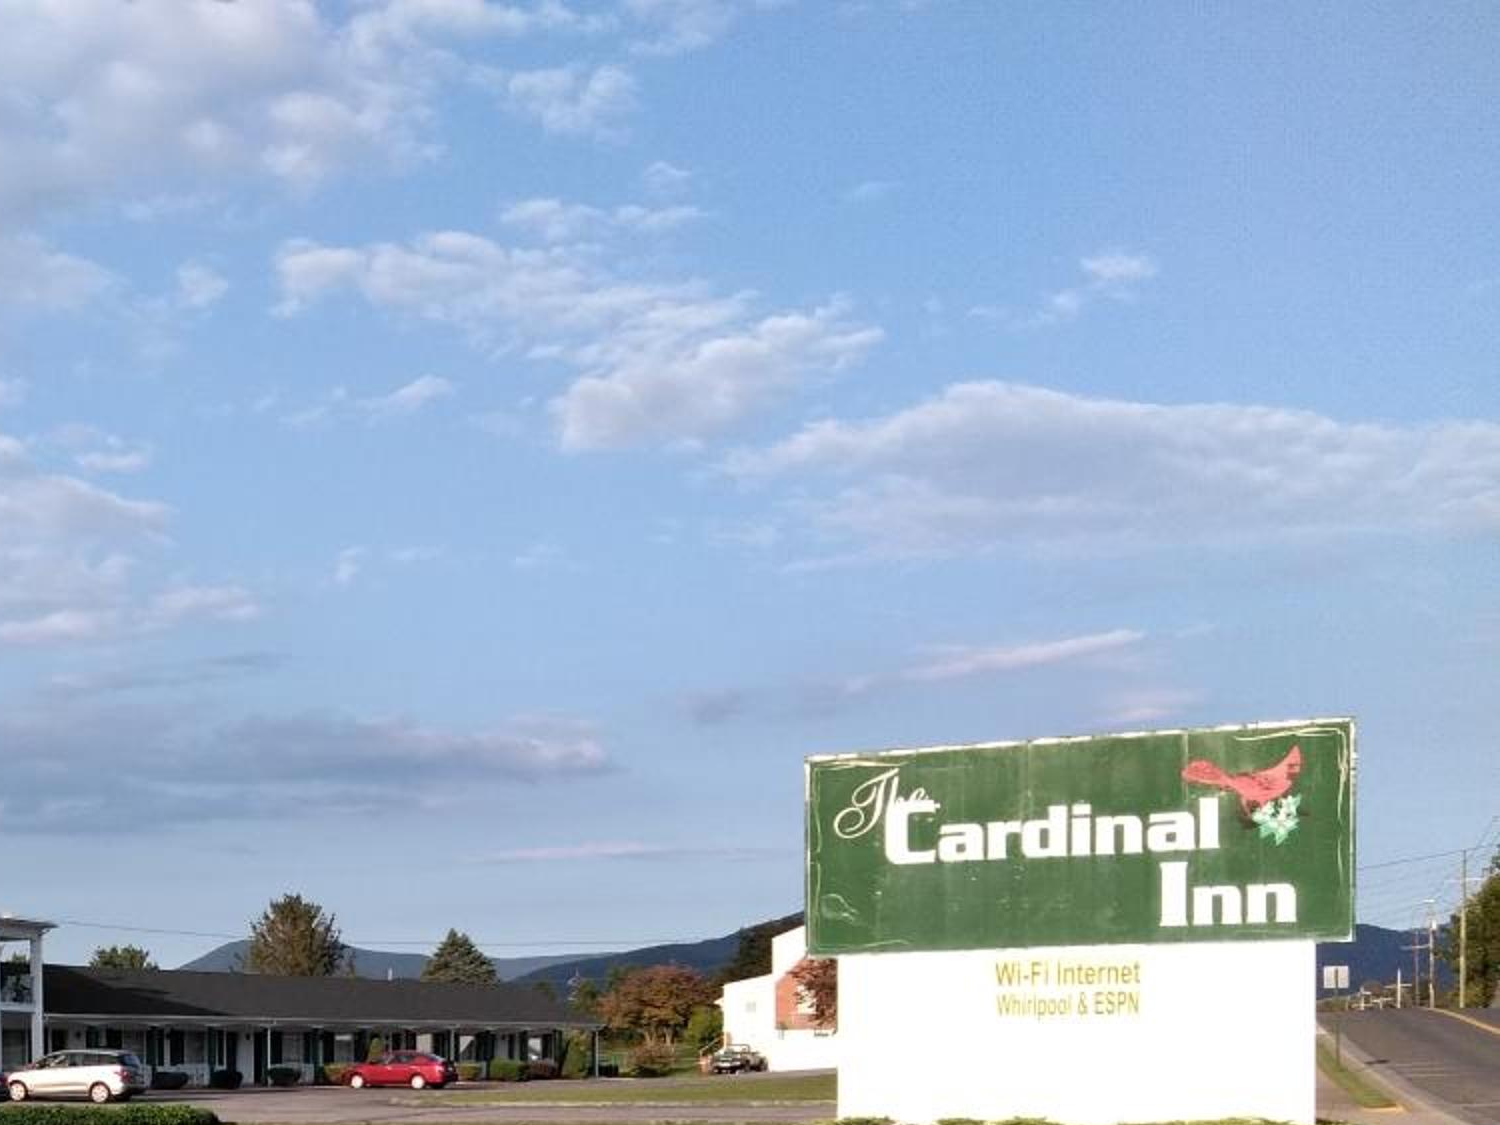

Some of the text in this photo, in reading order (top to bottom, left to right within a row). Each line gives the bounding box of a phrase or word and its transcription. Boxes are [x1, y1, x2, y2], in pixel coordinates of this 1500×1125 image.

[884, 796, 1220, 865] Cardinal
[1158, 861, 1298, 928] Inn
[995, 960, 1141, 986] Wi-Fi Internet
[997, 991, 1140, 1022] Whirlpool & ESPN
